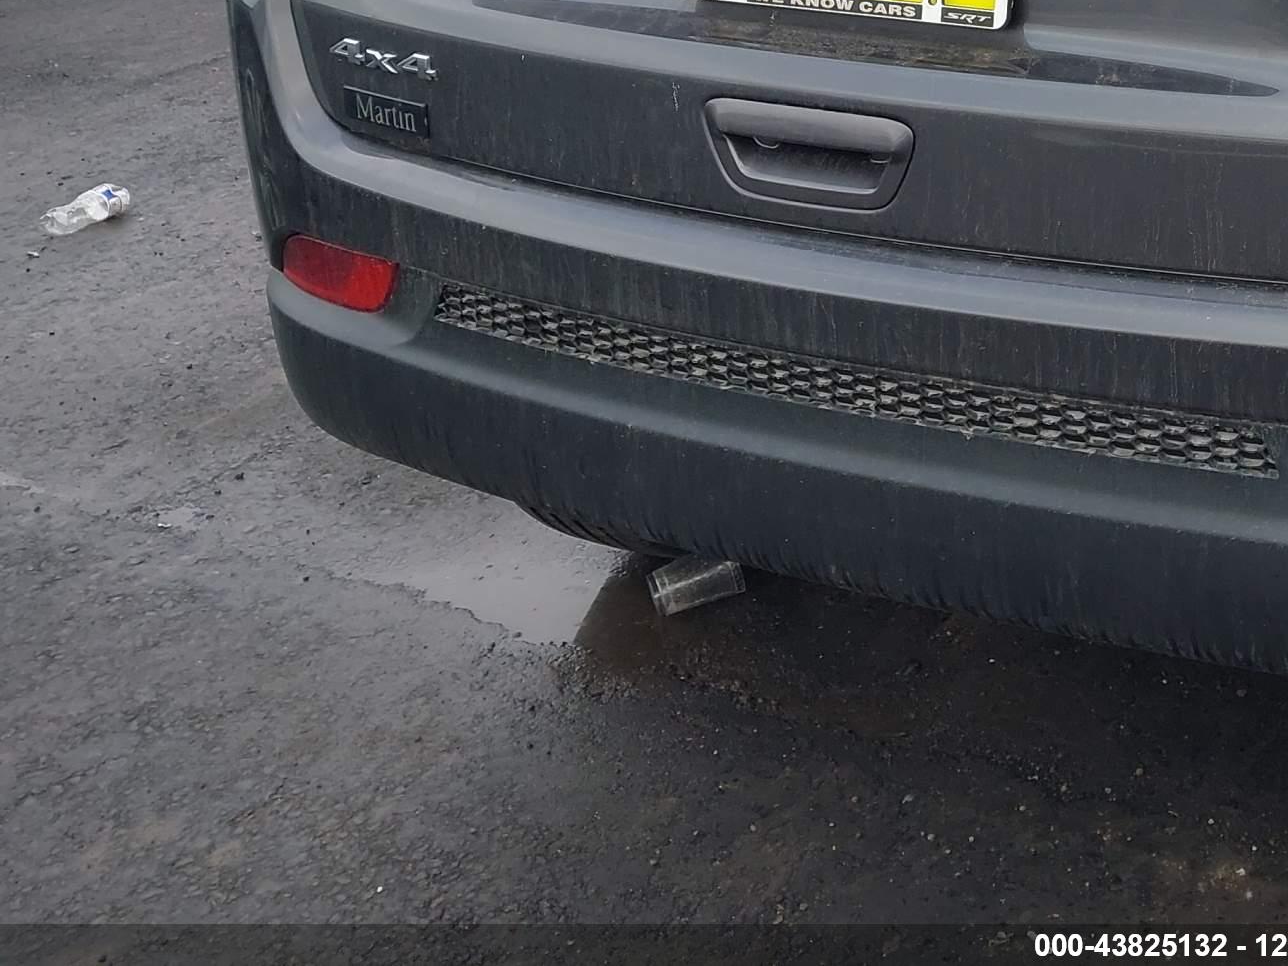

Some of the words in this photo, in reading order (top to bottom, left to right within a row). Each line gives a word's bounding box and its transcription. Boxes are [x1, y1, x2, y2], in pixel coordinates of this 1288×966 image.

[859, 2, 917, 18] CARS
[943, 11, 992, 24] SRT
[355, 93, 417, 133] Martin
